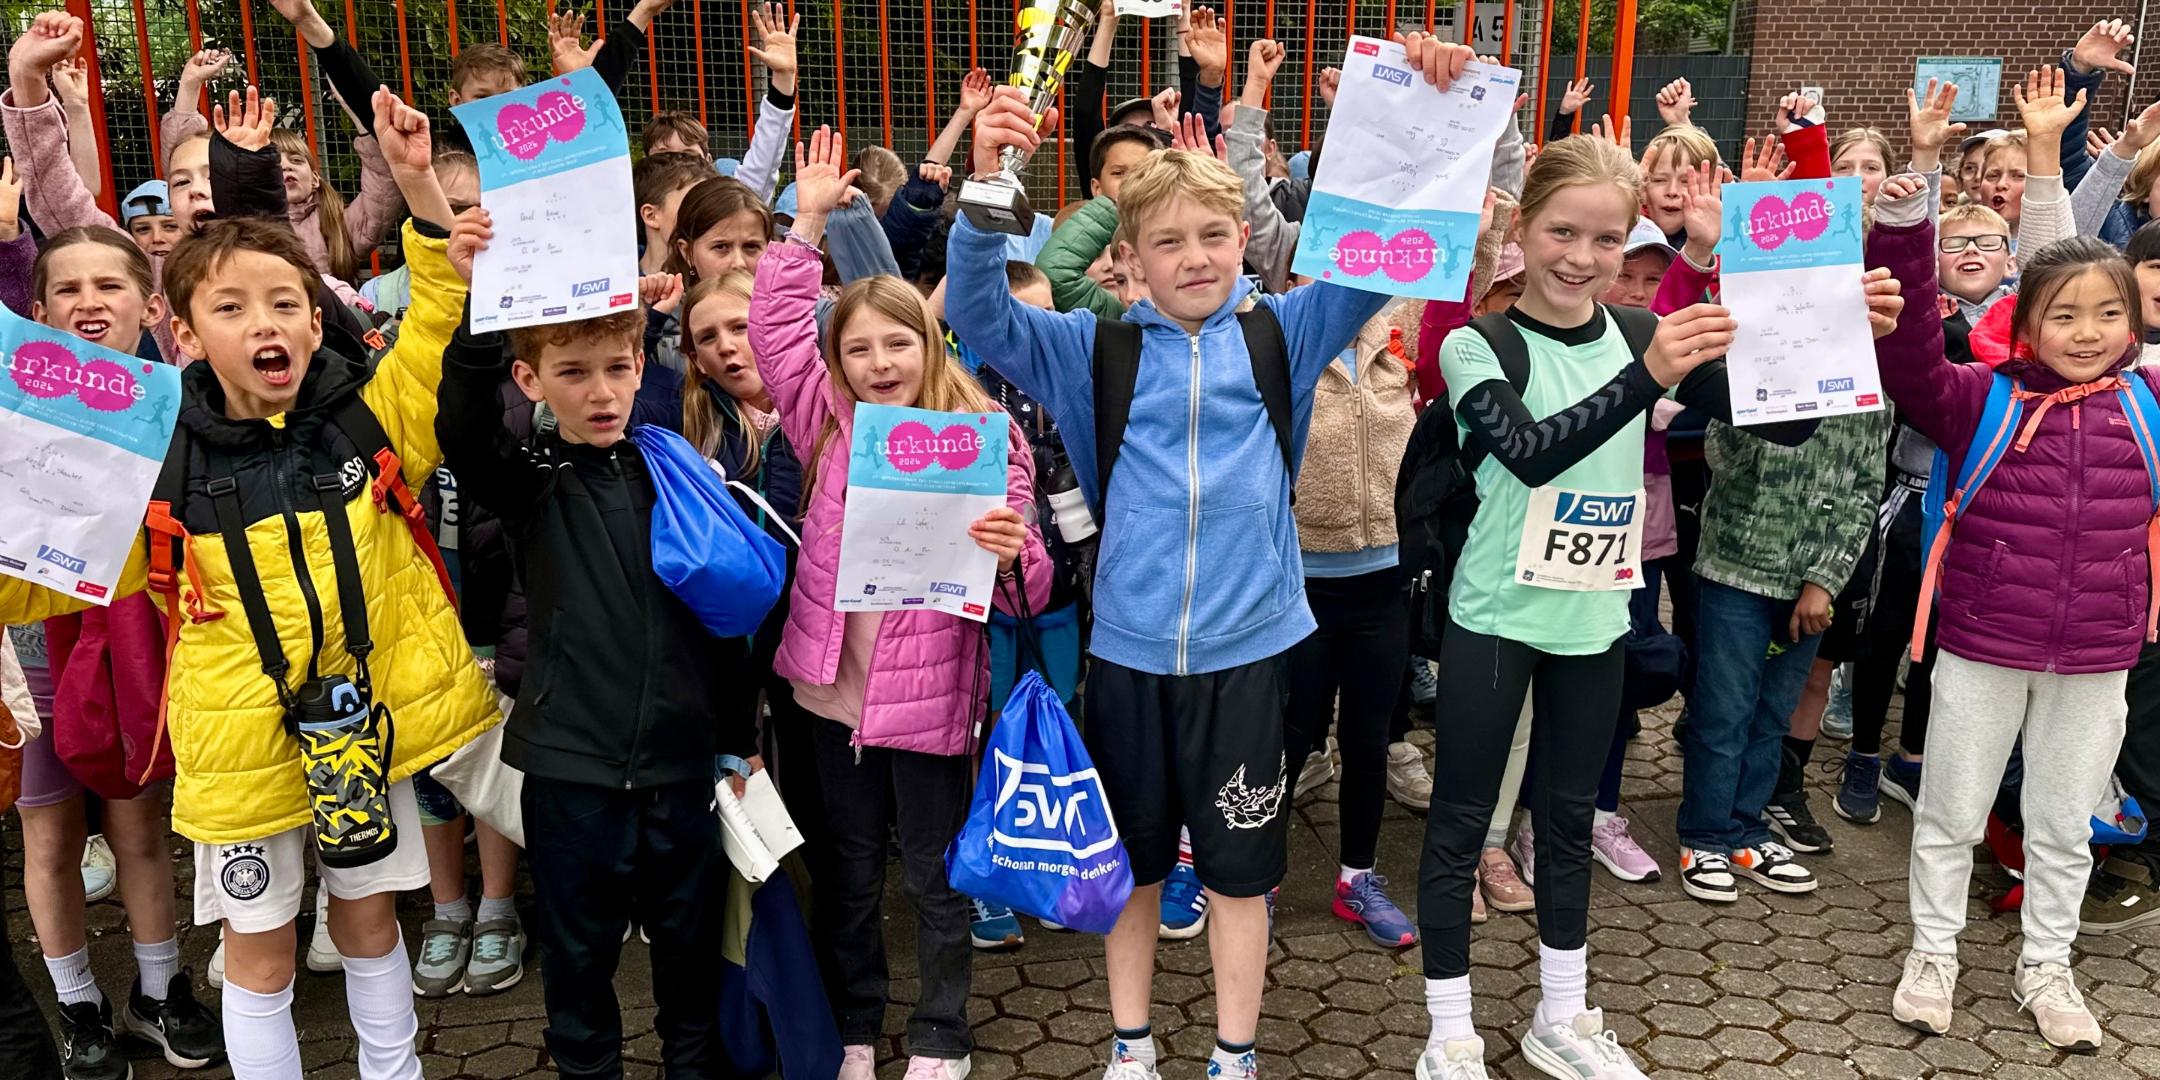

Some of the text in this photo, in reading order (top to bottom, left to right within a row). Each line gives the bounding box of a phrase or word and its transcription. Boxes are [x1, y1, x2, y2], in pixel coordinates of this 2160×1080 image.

[1491, 16, 1505, 42] 5
[1374, 67, 1403, 81] SWT
[490, 93, 588, 150] urkunde
[518, 141, 538, 155] 2026
[1740, 199, 1836, 236] urkunde
[1400, 236, 1424, 245] 2026
[1760, 235, 1779, 244] 2026
[1327, 246, 1447, 268] urkunde
[582, 279, 609, 294] SWT
[0, 351, 147, 401] urkunde
[24, 379, 55, 392] 2026
[1826, 379, 1852, 392] SWT
[875, 433, 987, 456] urkunde
[898, 457, 921, 466] 2026
[1580, 500, 1633, 522] SWT
[1544, 529, 1627, 565] F871
[51, 553, 83, 574] SWT
[938, 584, 966, 595] SWT
[349, 827, 379, 842] THERMOS
